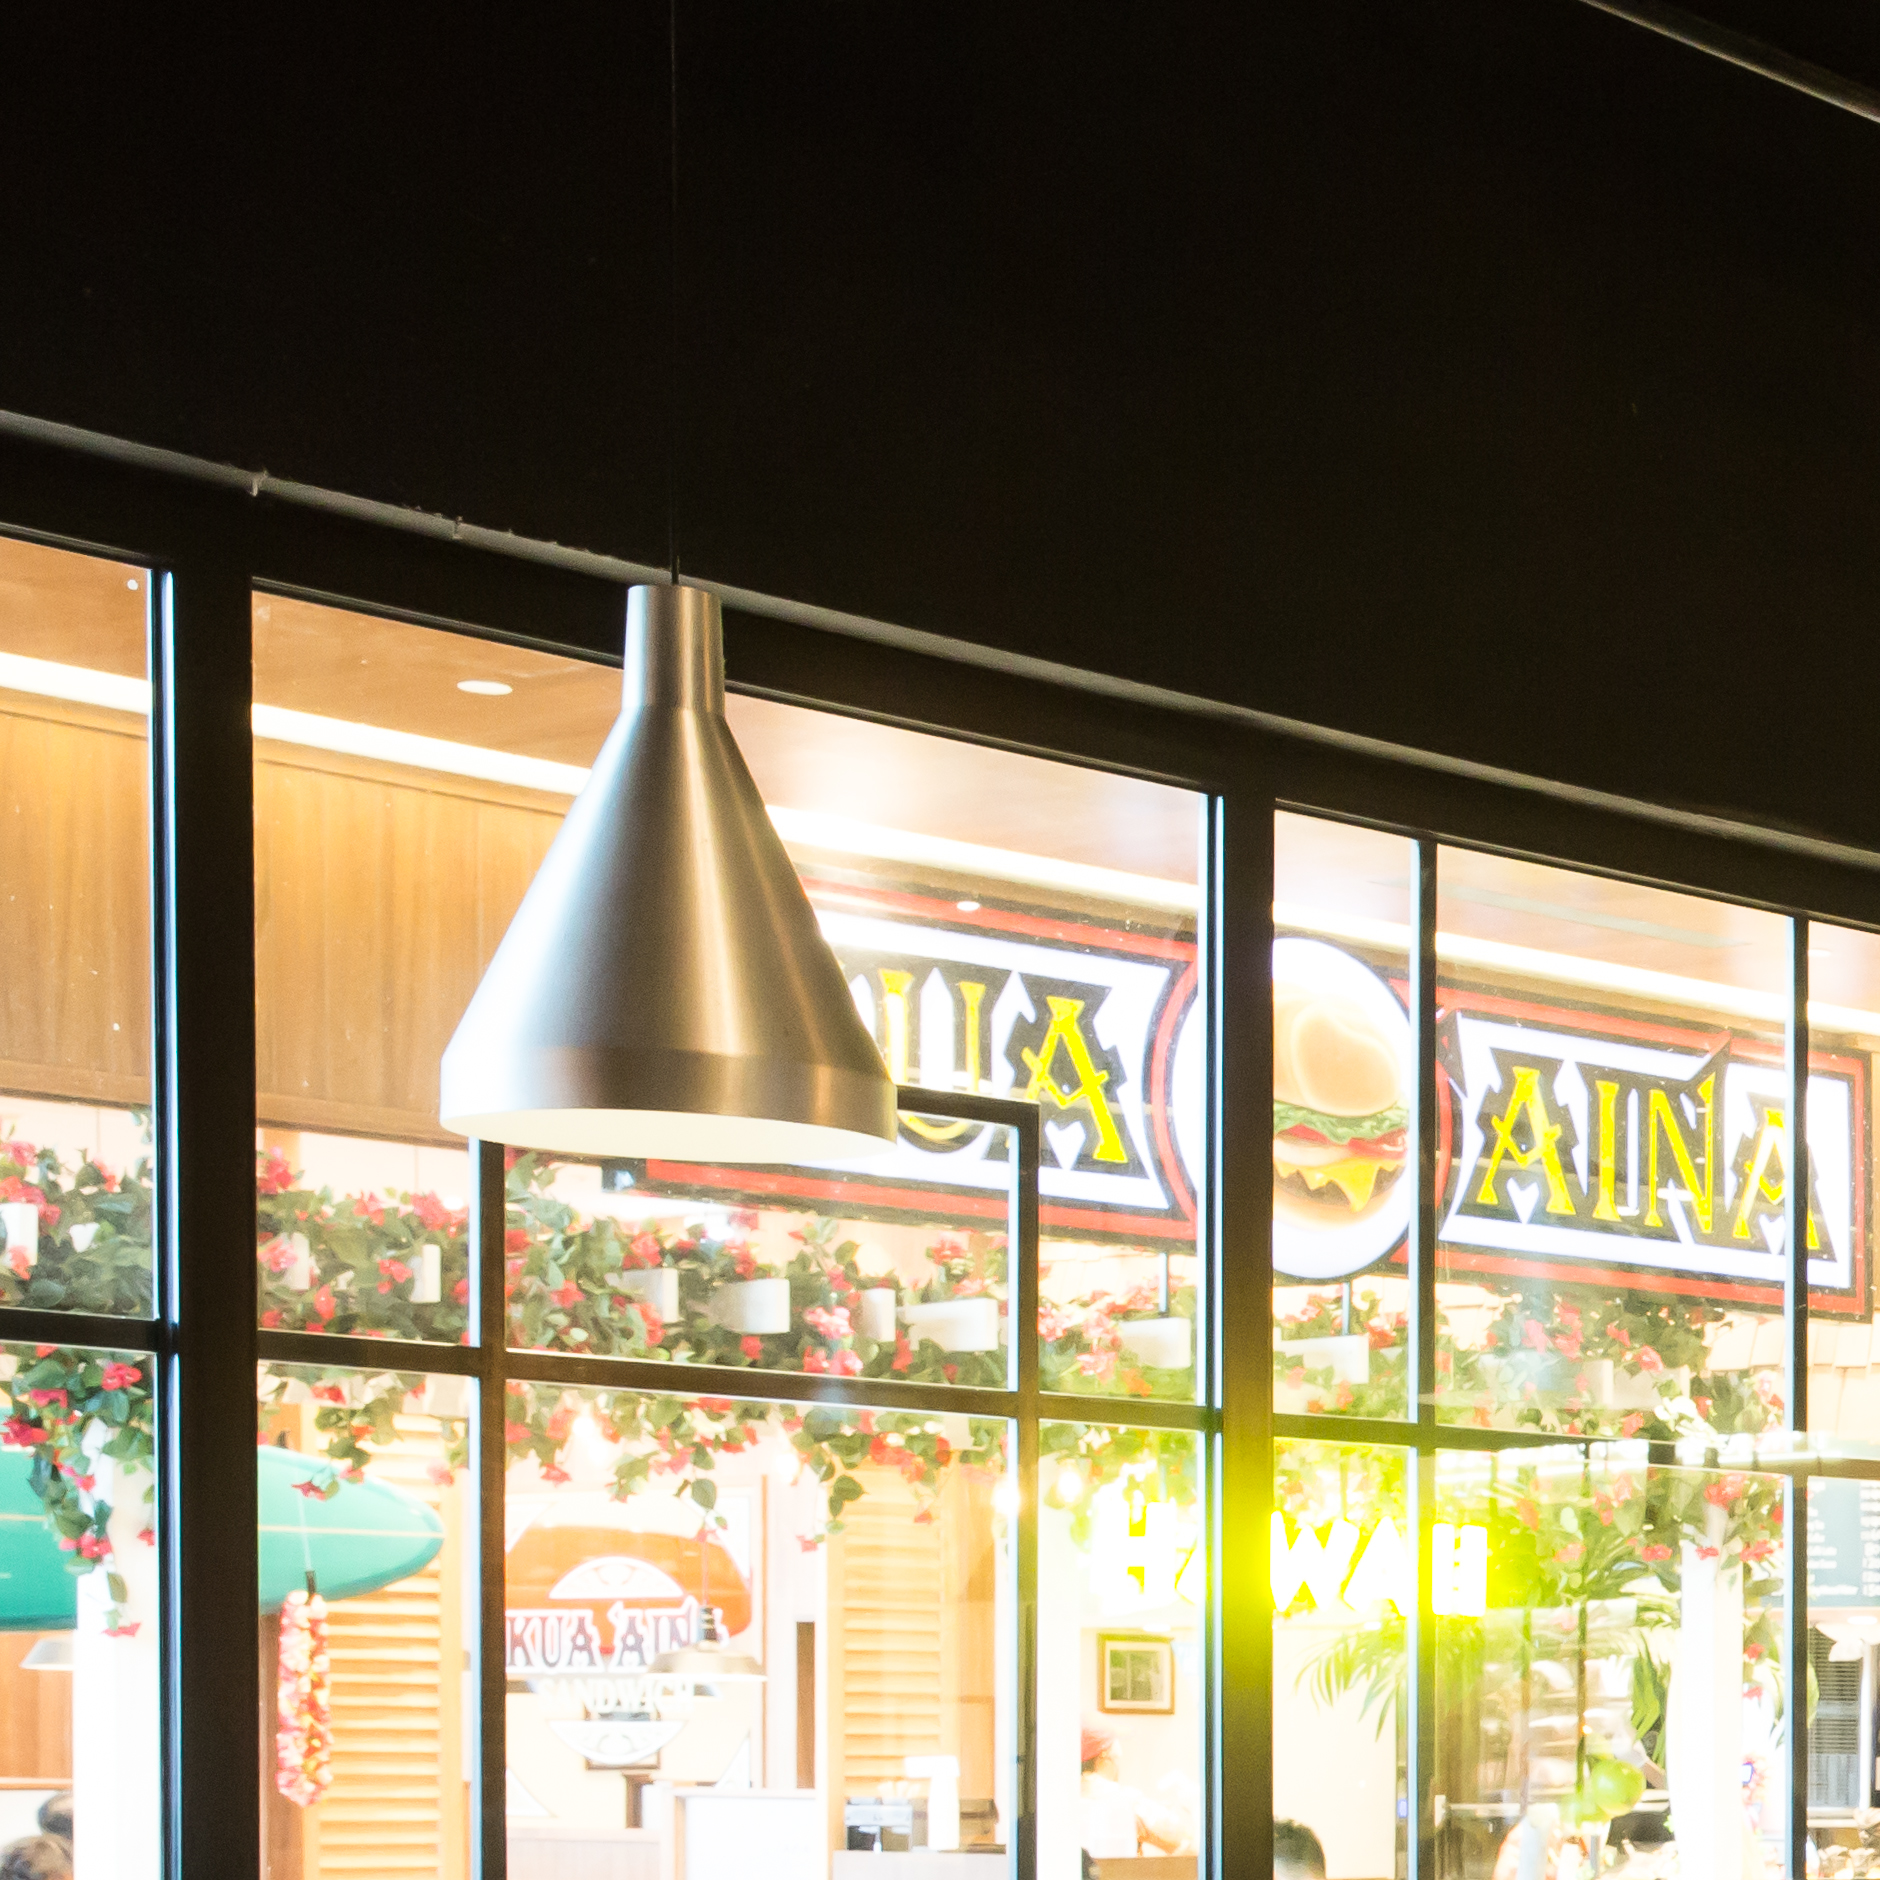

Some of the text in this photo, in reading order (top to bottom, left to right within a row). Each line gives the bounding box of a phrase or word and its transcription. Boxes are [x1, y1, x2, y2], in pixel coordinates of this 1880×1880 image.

[878, 966, 1130, 1166] UA
[507, 1614, 600, 1669] KUA
[536, 1677, 696, 1713] SANDWICH
